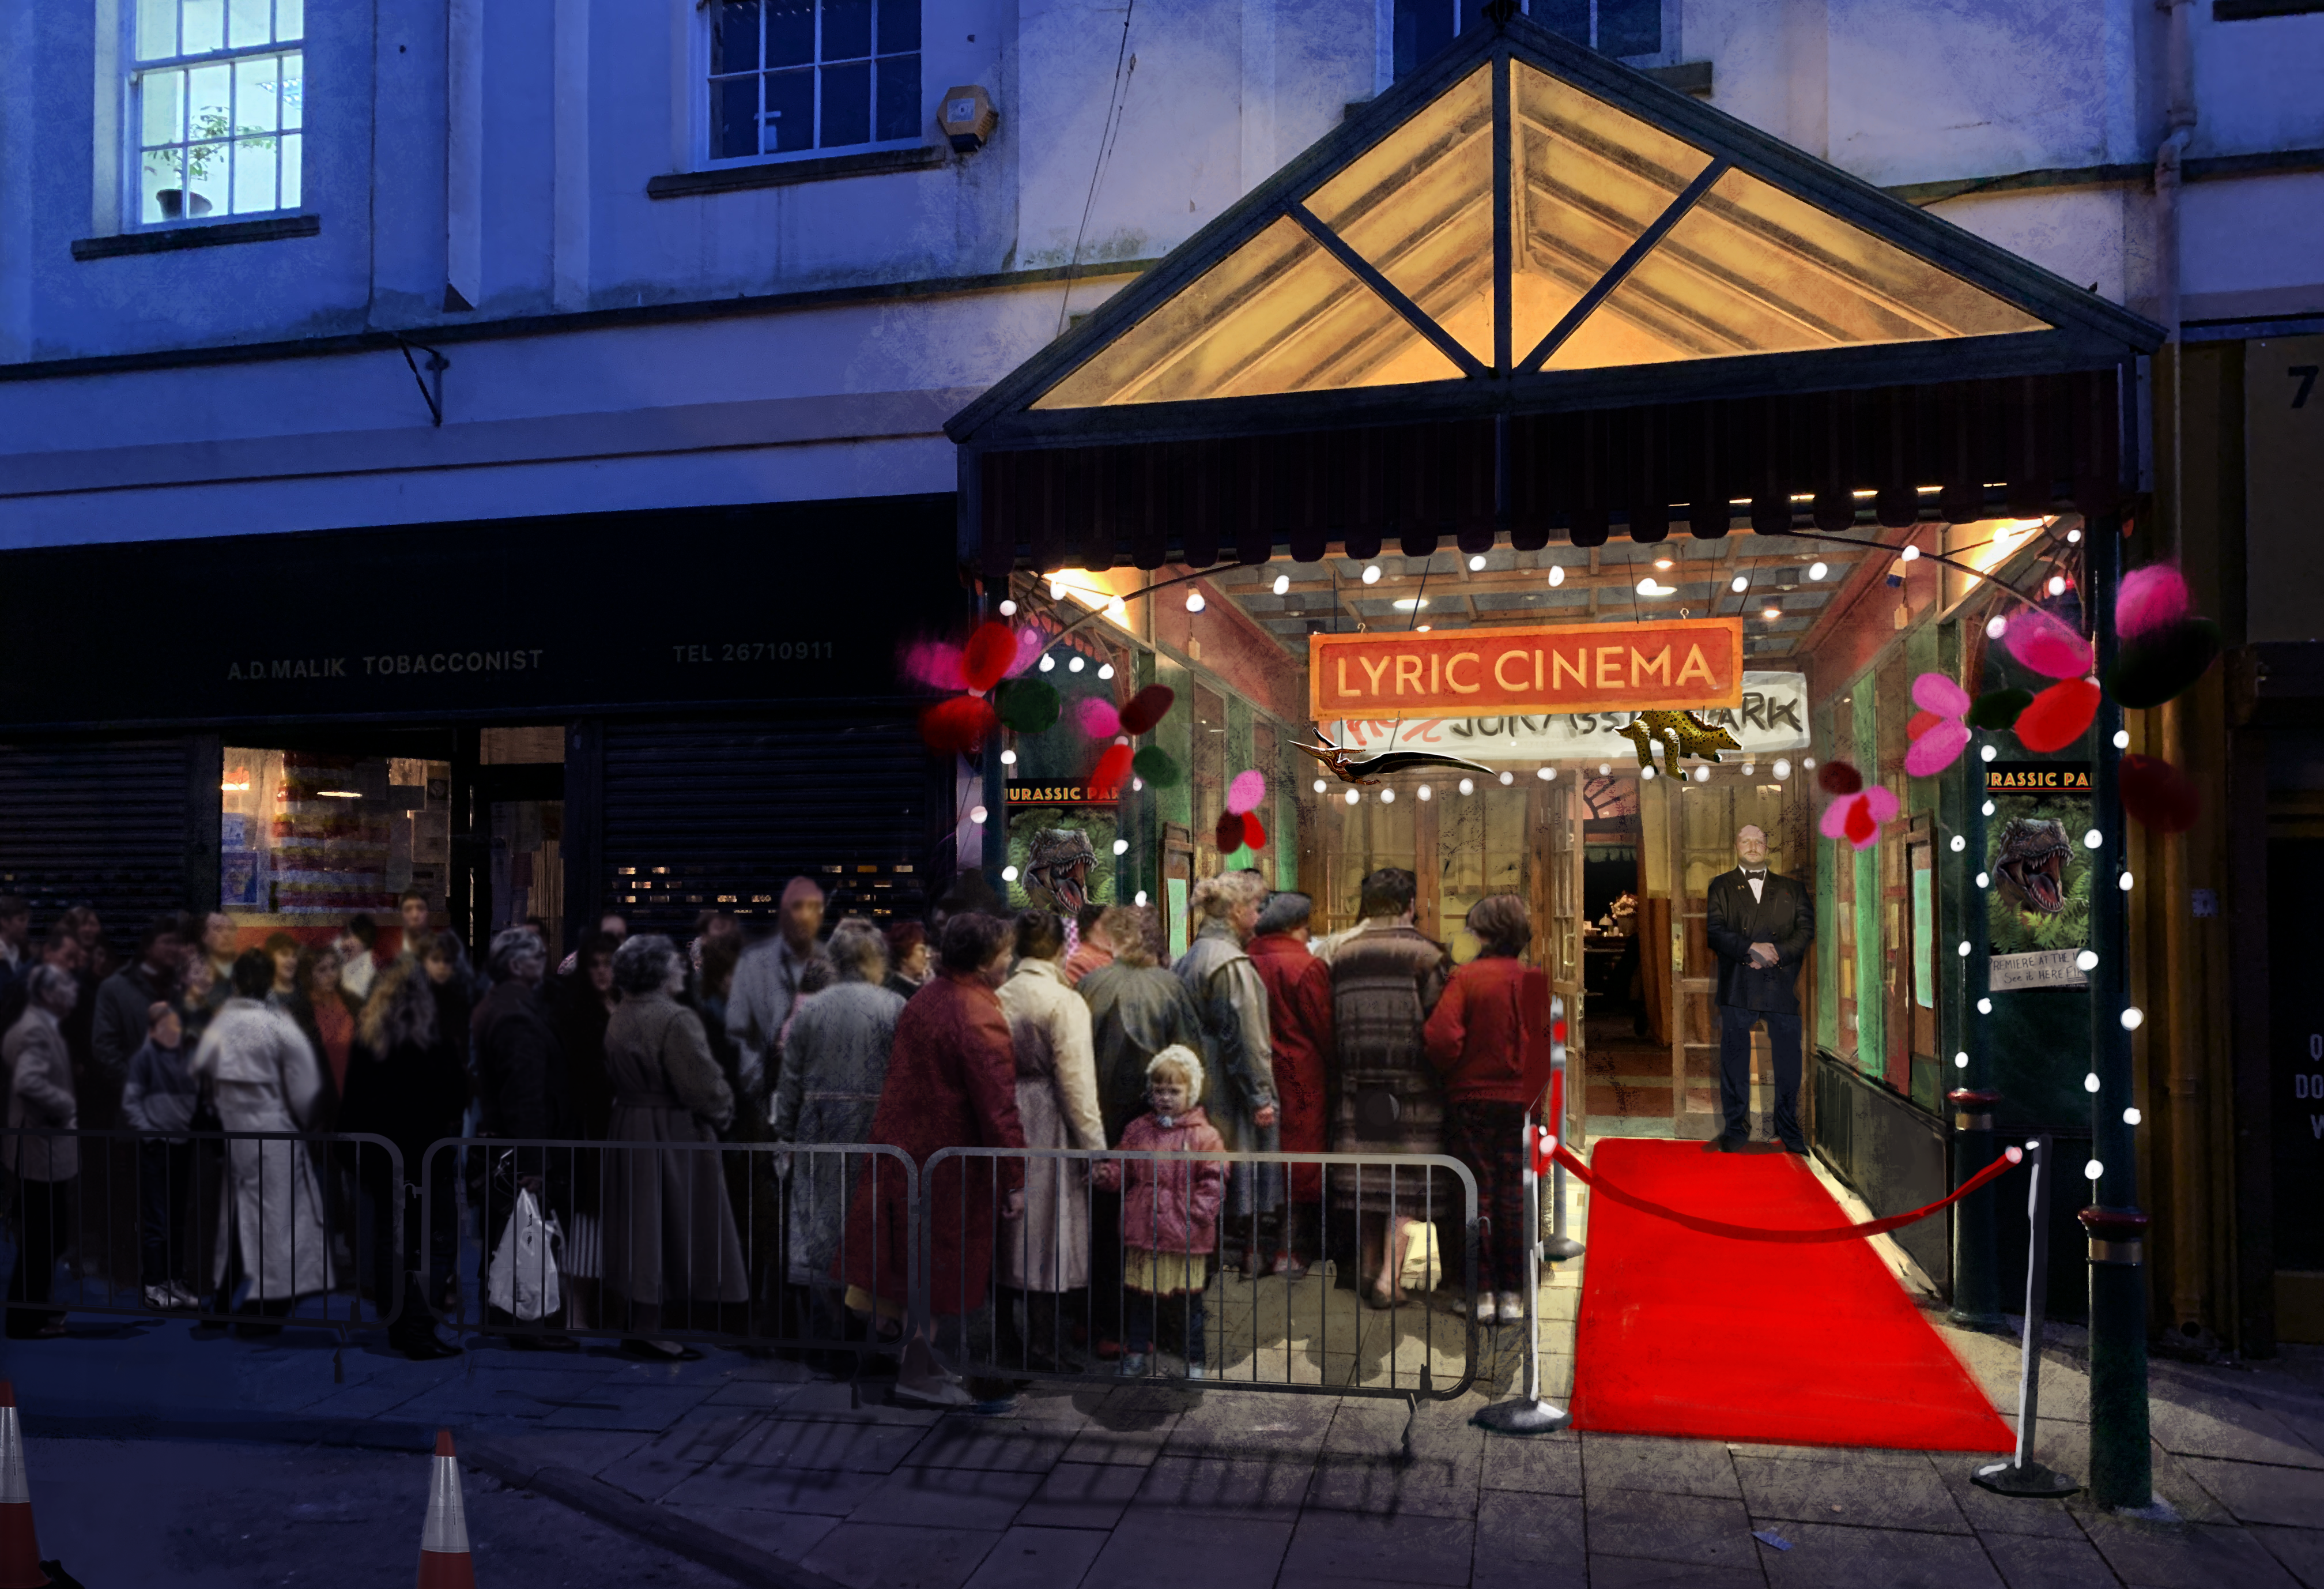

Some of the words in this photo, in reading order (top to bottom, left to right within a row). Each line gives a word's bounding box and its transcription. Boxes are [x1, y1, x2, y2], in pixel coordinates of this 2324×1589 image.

[2288, 365, 2319, 409] 7
[362, 649, 544, 675] TOBACCONIST
[673, 645, 714, 662] TEL
[722, 641, 833, 661] 26710911
[1338, 653, 1481, 697] LYRIC
[1494, 643, 1716, 691] CINEMA
[2063, 771, 2091, 786] PA
[2039, 955, 2048, 965] AT
[2050, 952, 2070, 963] THE
[2004, 972, 2022, 984] See
[2026, 972, 2033, 981] it
[2039, 969, 2063, 980] HERE
